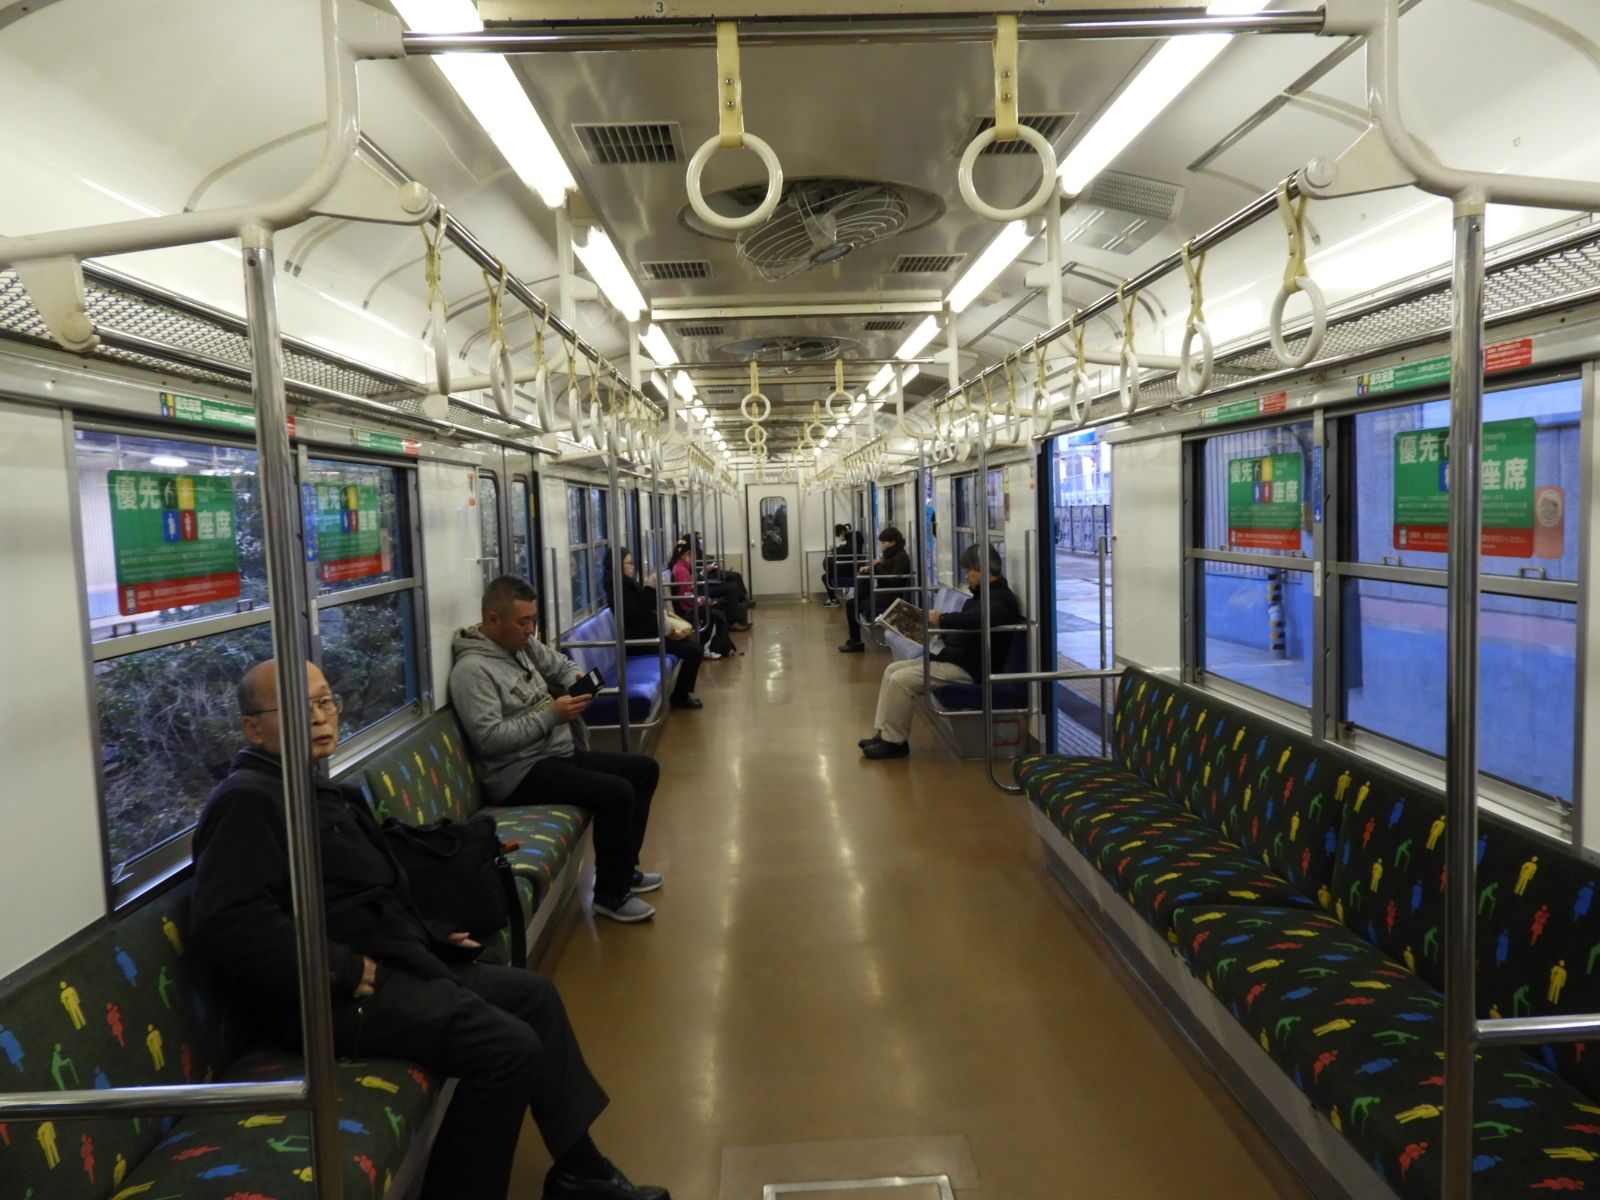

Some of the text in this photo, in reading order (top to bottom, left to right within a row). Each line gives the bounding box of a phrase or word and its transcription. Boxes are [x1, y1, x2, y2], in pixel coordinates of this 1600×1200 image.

[655, 1, 664, 13] 3
[1399, 433, 1439, 464] 優先
[1482, 457, 1529, 490] 座席
[115, 476, 161, 510] 優先
[198, 510, 232, 539] 座席
